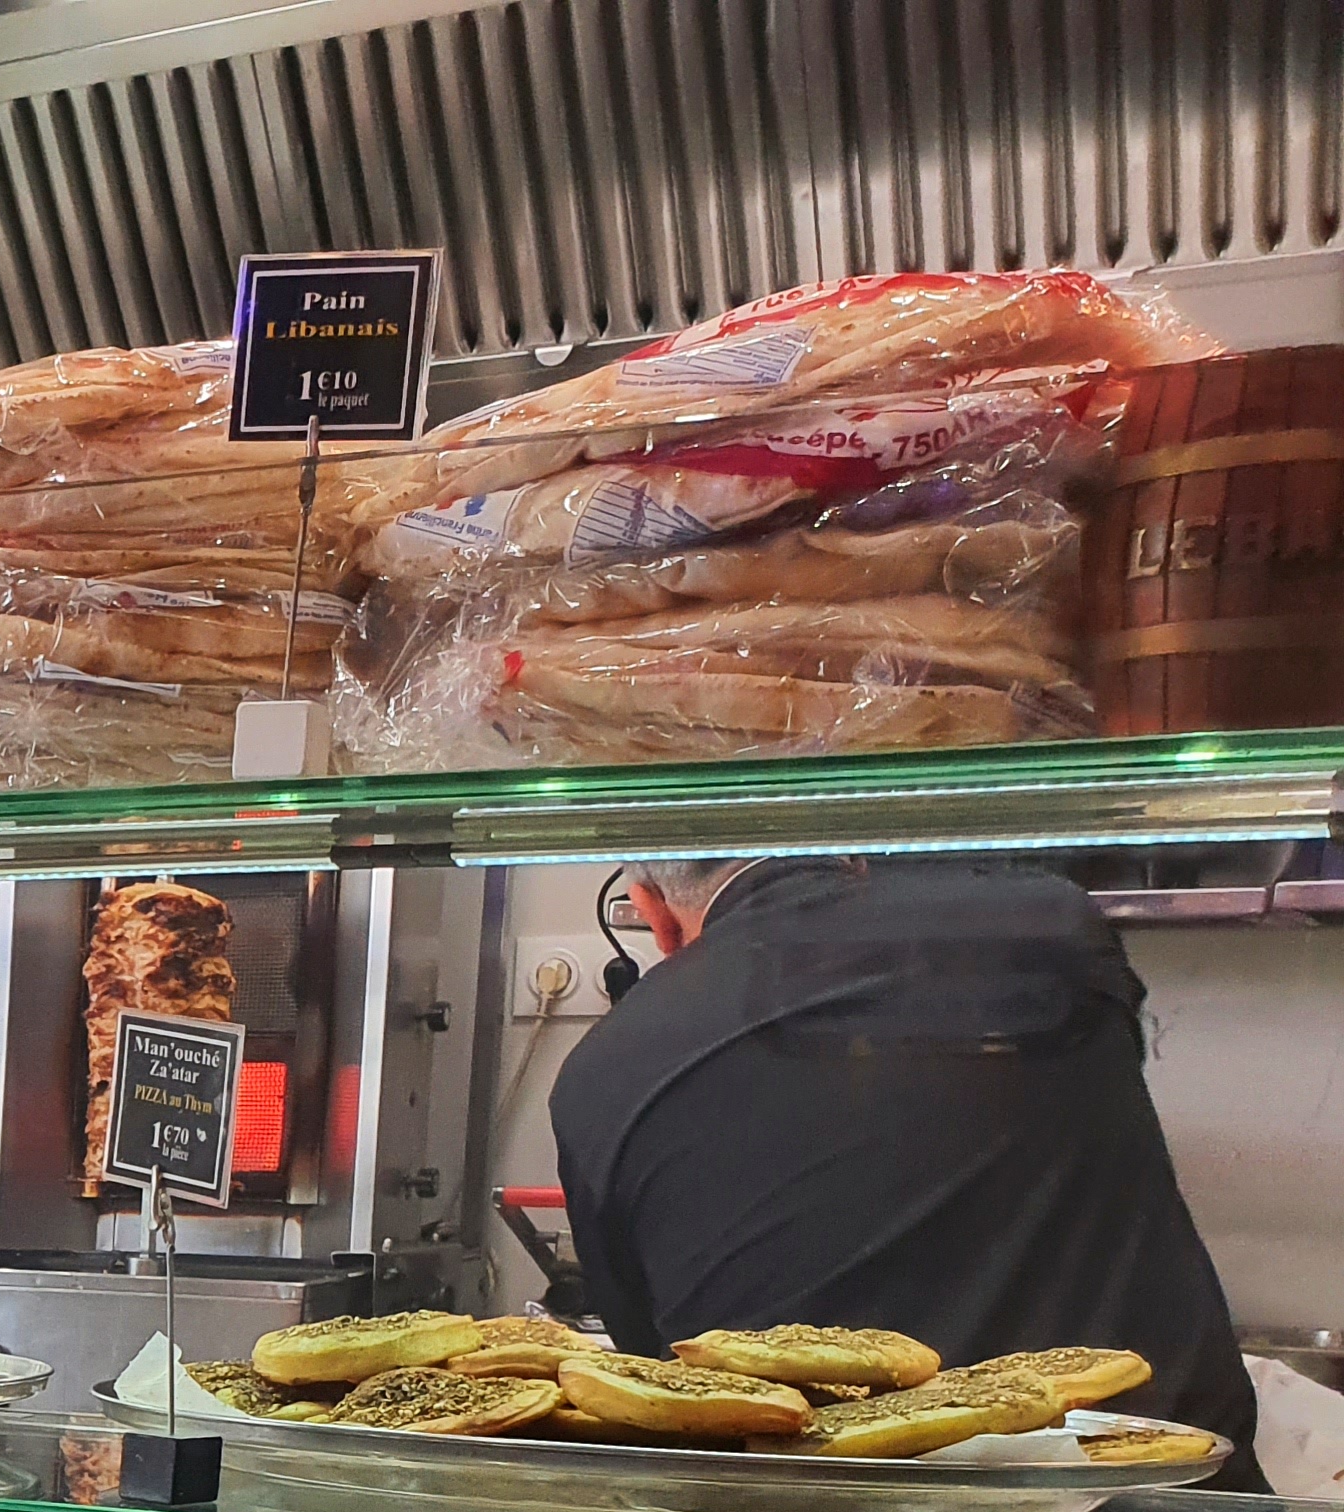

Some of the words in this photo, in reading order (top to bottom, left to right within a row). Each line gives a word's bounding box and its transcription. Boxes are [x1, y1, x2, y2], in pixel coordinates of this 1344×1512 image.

[303, 290, 365, 311] Pain
[265, 319, 399, 339] Libanais
[299, 370, 357, 400] 1€10
[318, 393, 328, 407] le
[330, 393, 369, 412] paquet
[134, 1036, 220, 1067] Man'ouché
[150, 1059, 200, 1084] Za'atar
[134, 1084, 167, 1105] PIZZA
[169, 1094, 182, 1108] au
[184, 1094, 212, 1115] Thym
[151, 1121, 190, 1148] 1€70
[162, 1144, 169, 1156] la
